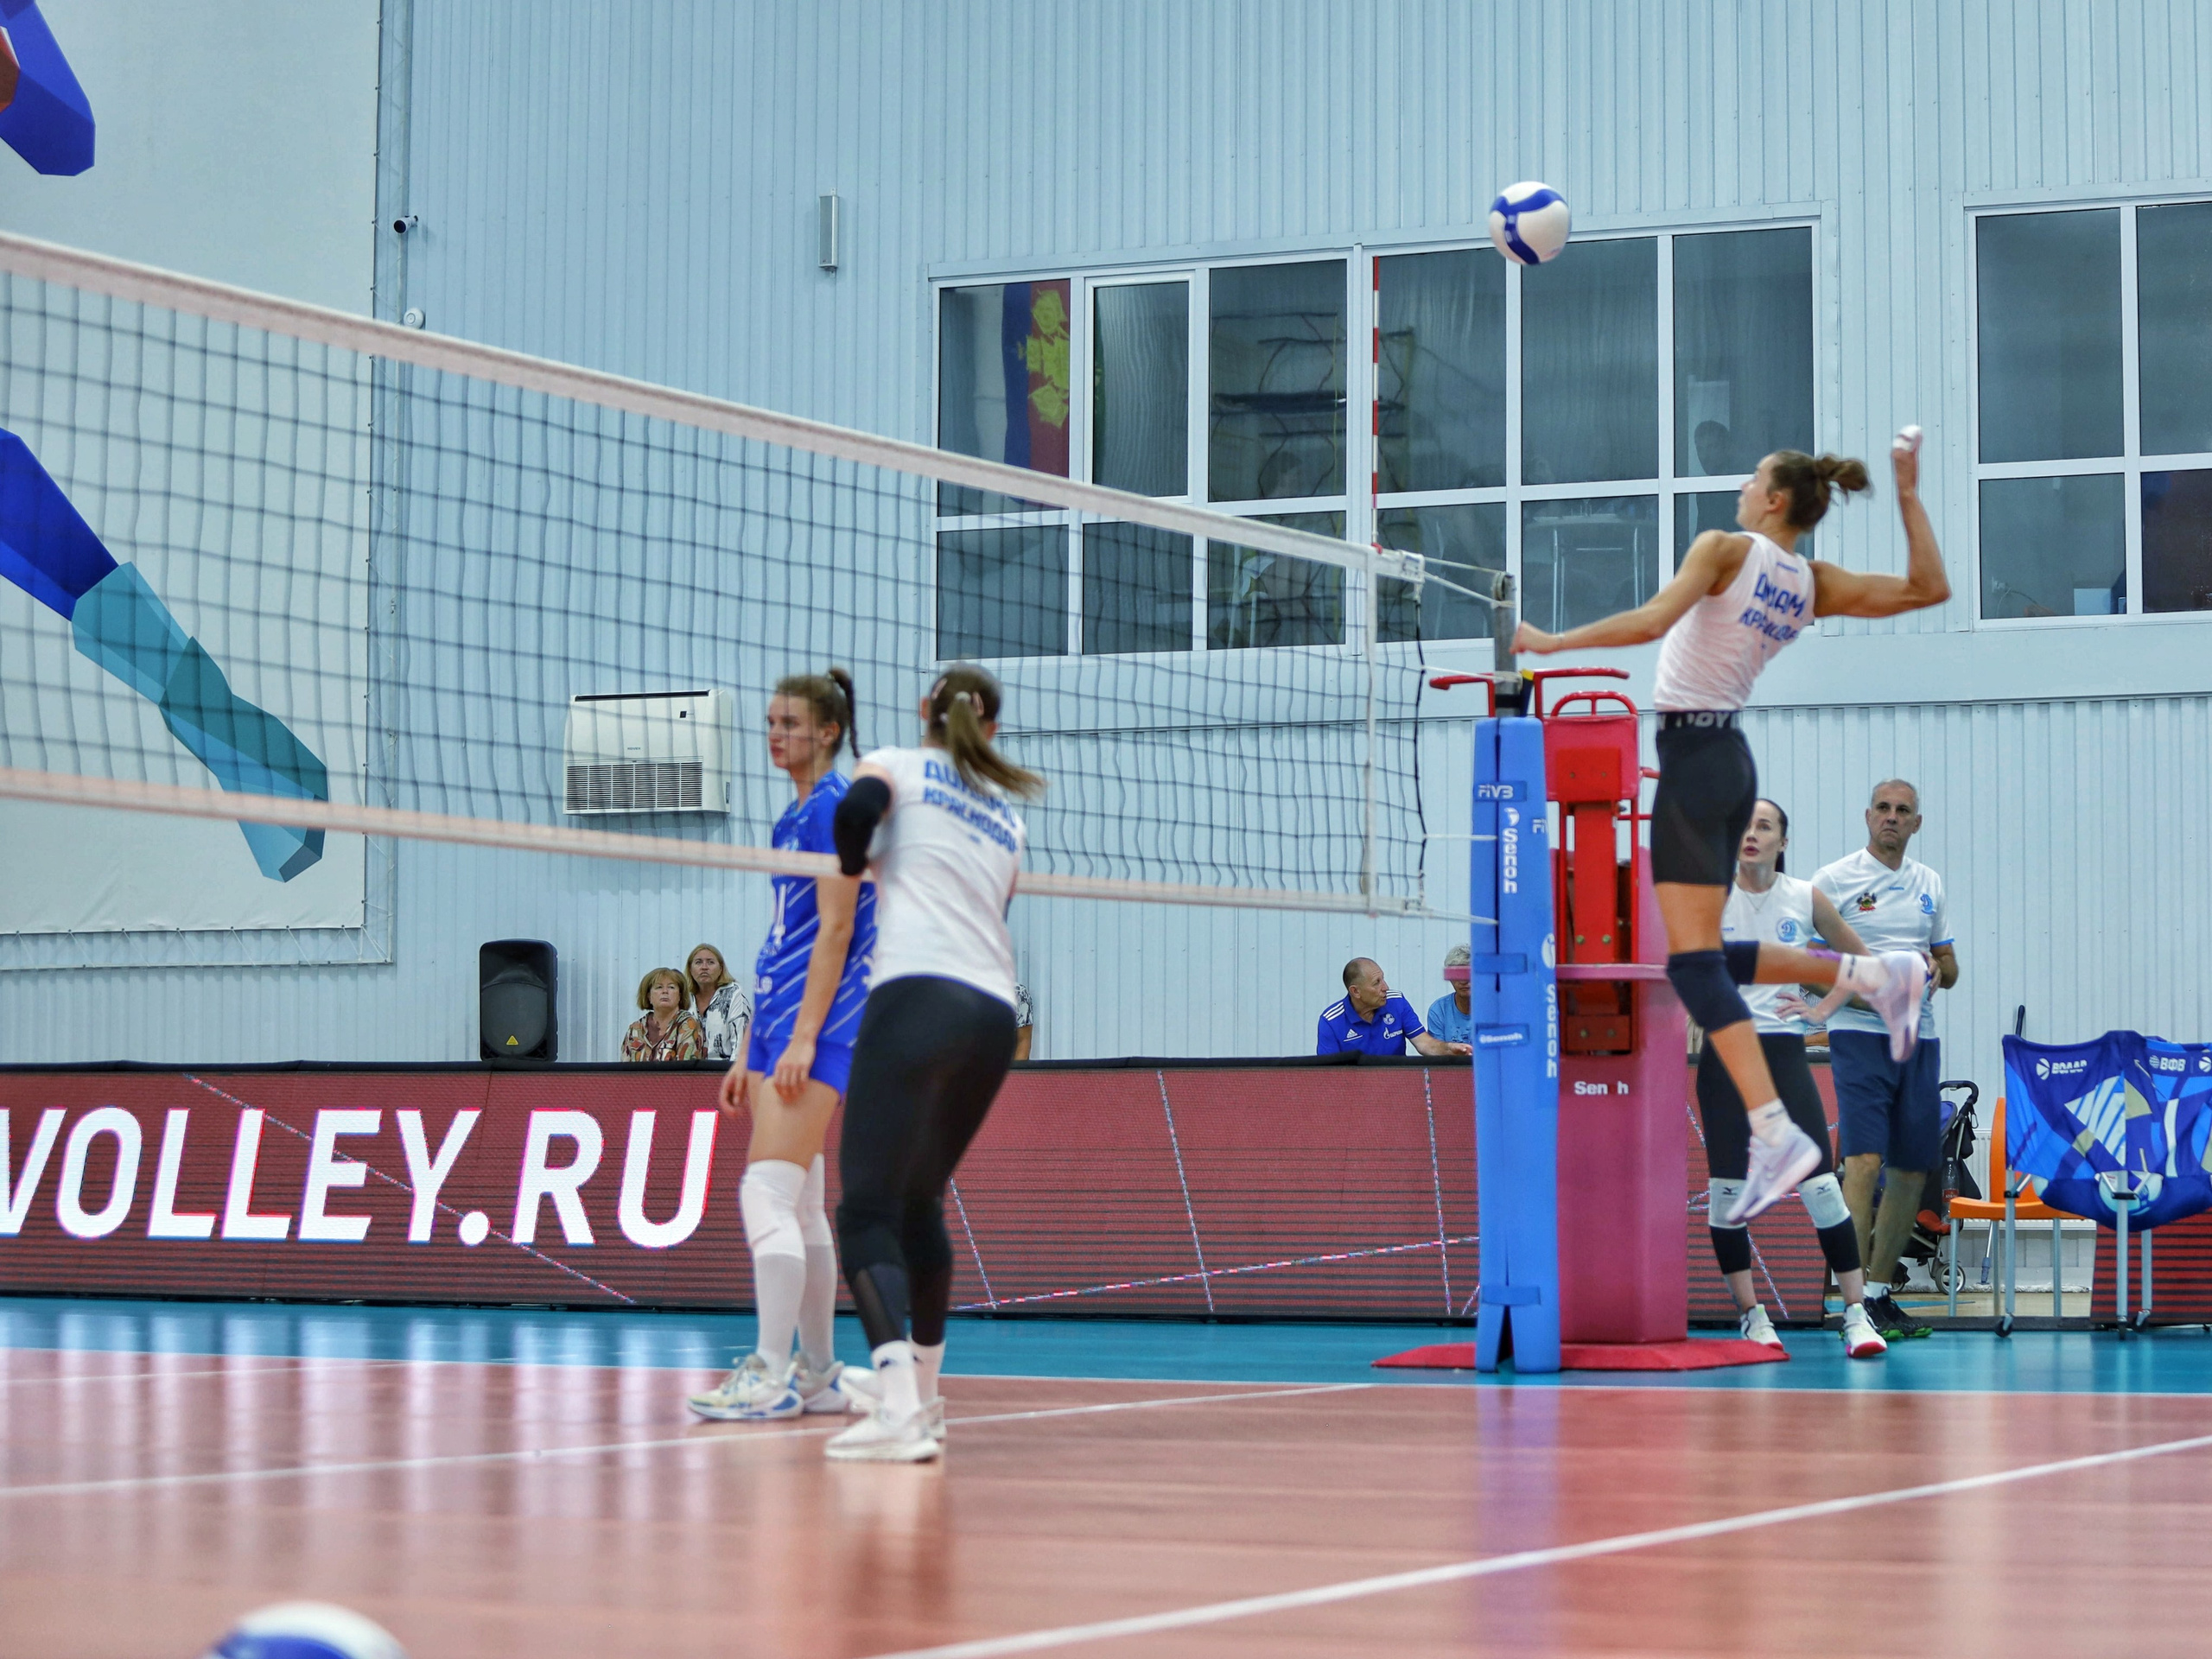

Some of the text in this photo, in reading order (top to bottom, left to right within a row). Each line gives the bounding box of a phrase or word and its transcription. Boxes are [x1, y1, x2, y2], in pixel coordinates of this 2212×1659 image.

[1503, 827, 1519, 894] Senoh
[1574, 1080, 1630, 1096] Senh
[0, 1108, 720, 1249] VOLLEY.RU
